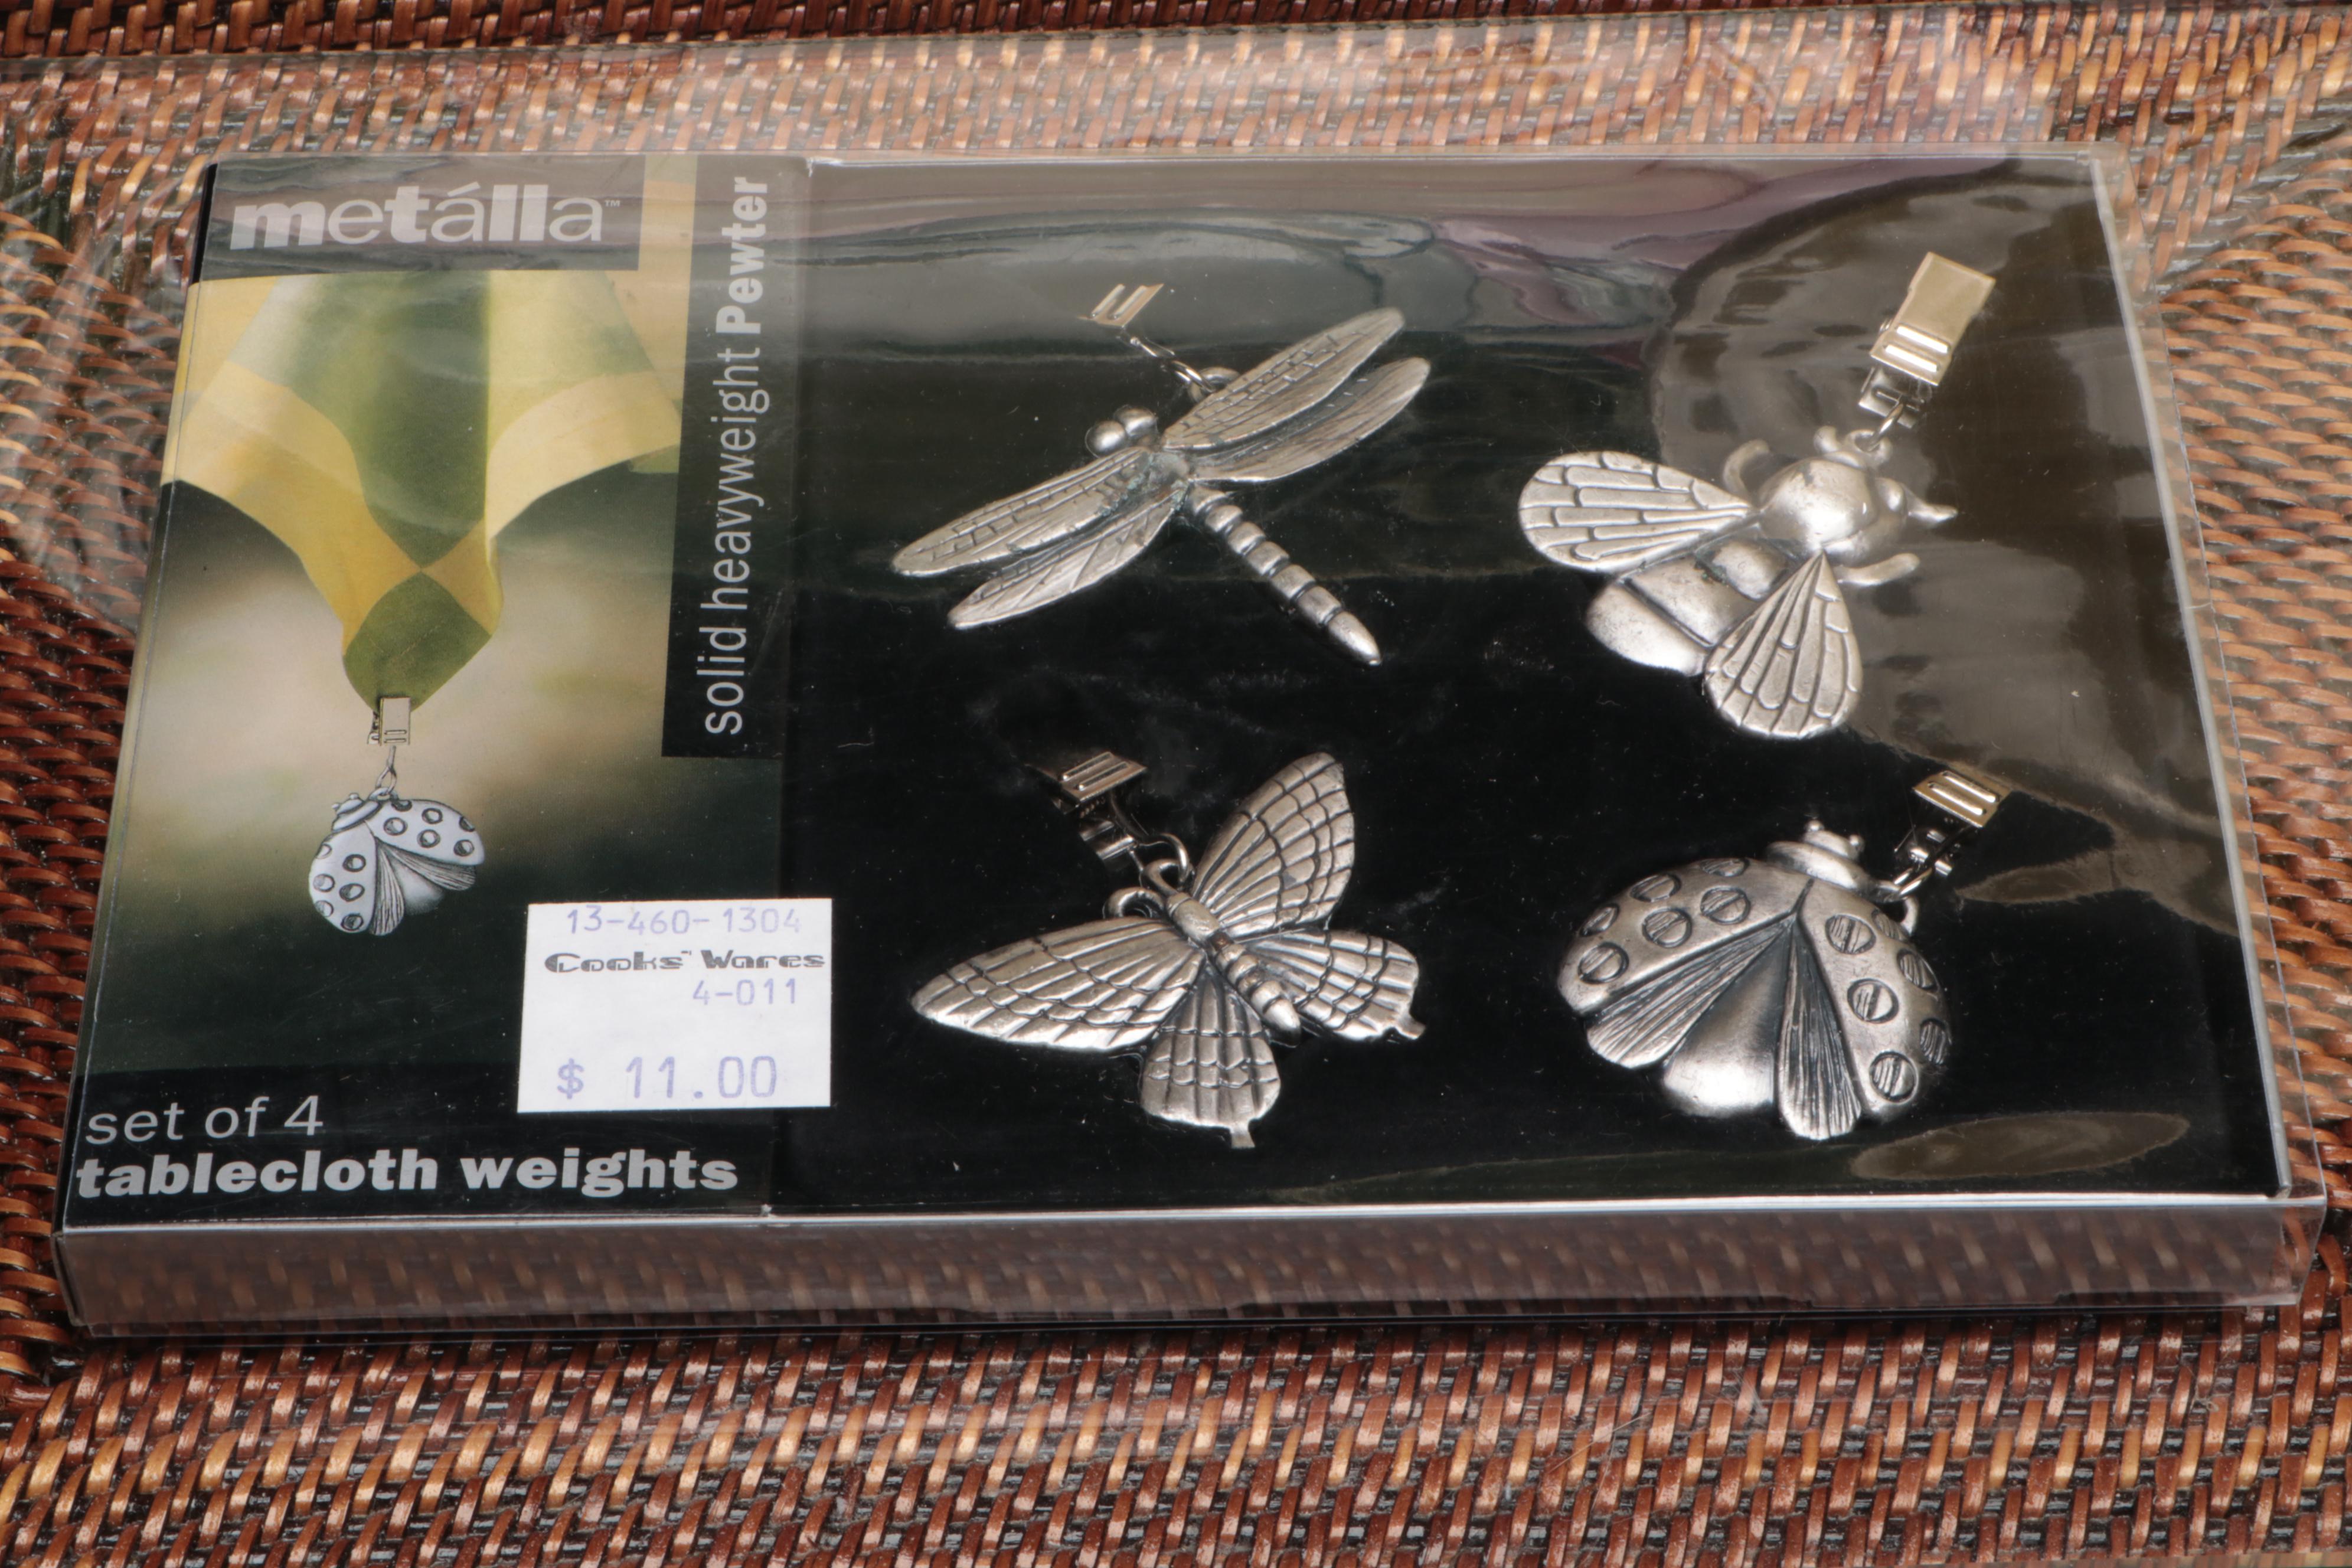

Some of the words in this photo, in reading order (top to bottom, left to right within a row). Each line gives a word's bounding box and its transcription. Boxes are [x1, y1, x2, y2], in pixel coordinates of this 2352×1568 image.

[716, 176, 768, 334] Pewter
[700, 347, 769, 610] heavyweight
[697, 626, 747, 735] solid
[567, 904, 802, 935] 13-460-1304
[701, 949, 825, 969] Wares
[692, 978, 797, 1005] 4-011
[557, 1059, 584, 1100] $
[626, 1056, 778, 1099] 11.00
[86, 1103, 184, 1144] set
[204, 1096, 269, 1139] of
[284, 1095, 324, 1136] 4
[75, 1149, 437, 1198] tablecloth
[460, 1148, 739, 1197] weights
